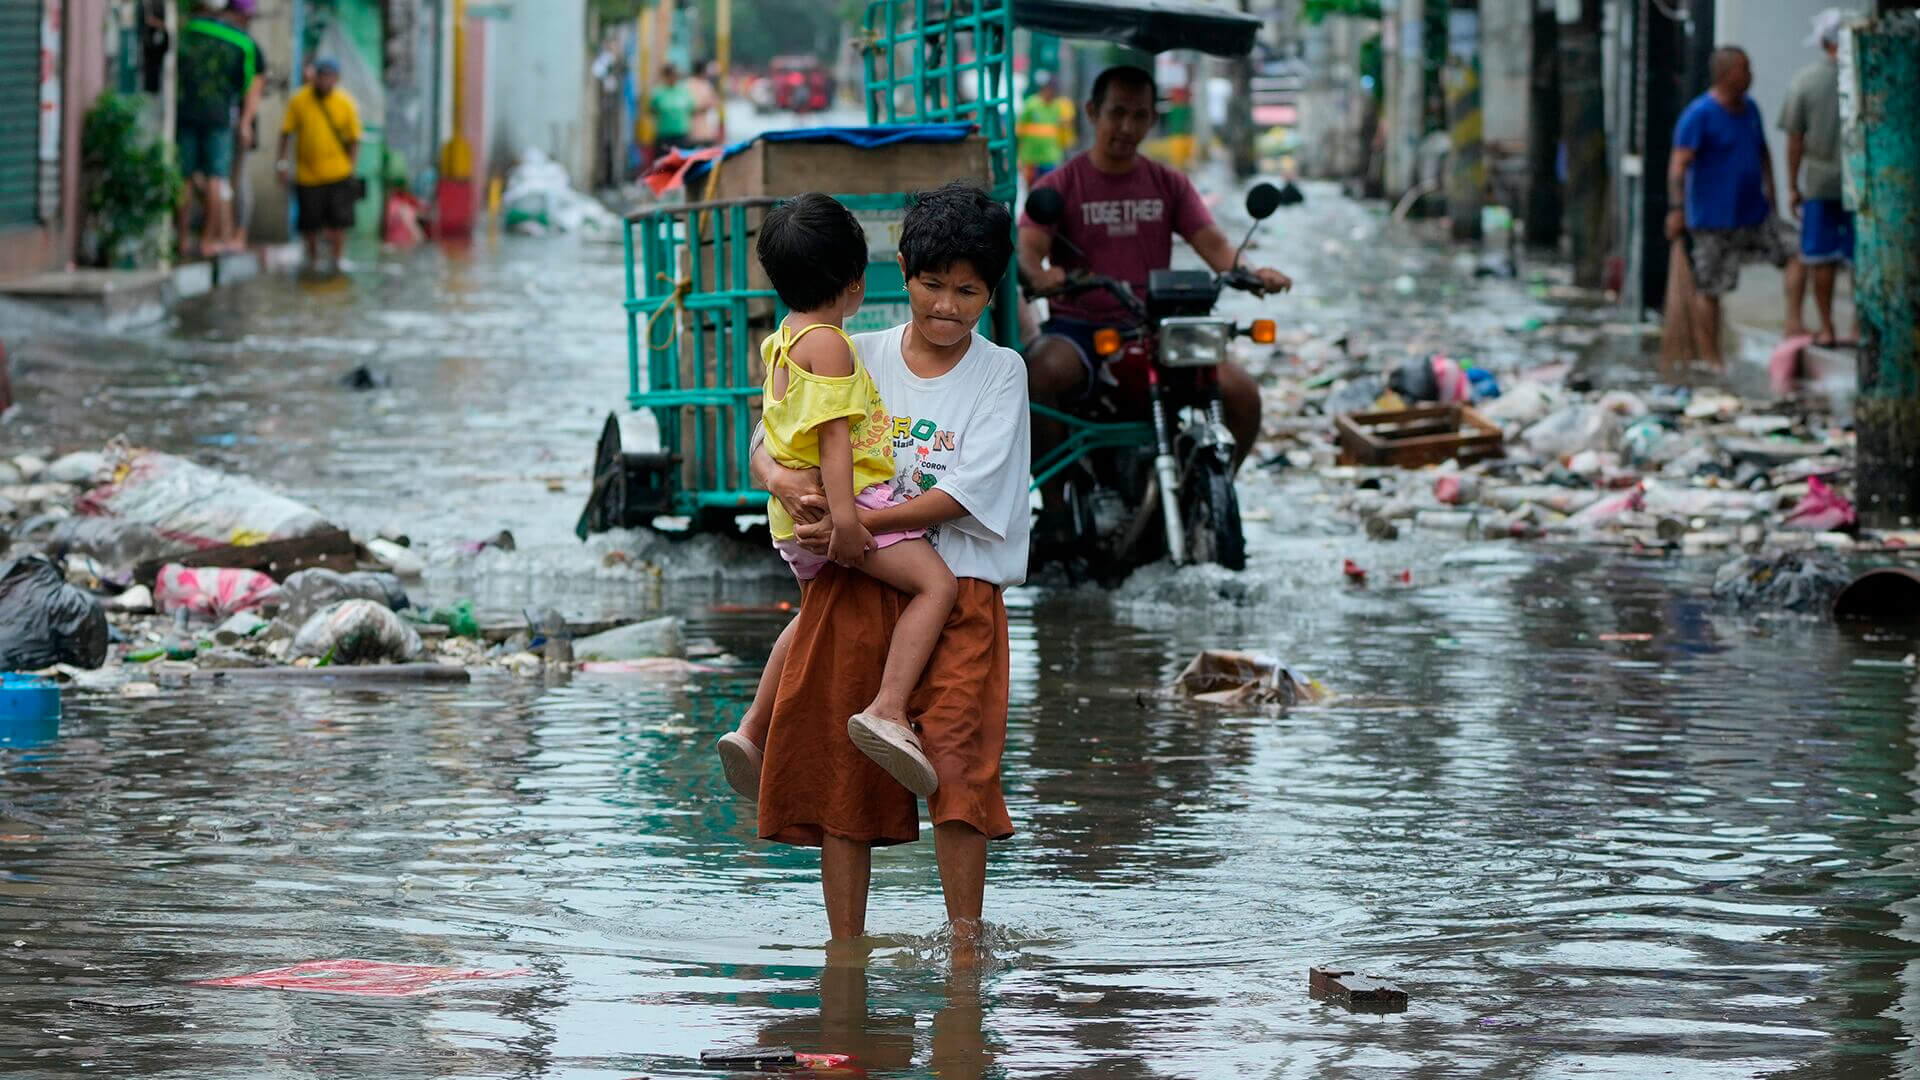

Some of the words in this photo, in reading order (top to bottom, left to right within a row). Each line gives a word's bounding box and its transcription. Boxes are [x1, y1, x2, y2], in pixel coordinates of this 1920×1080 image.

[1081, 199, 1164, 225] TOGETHER
[892, 416, 955, 452] RON
[921, 461, 947, 471] CORON
